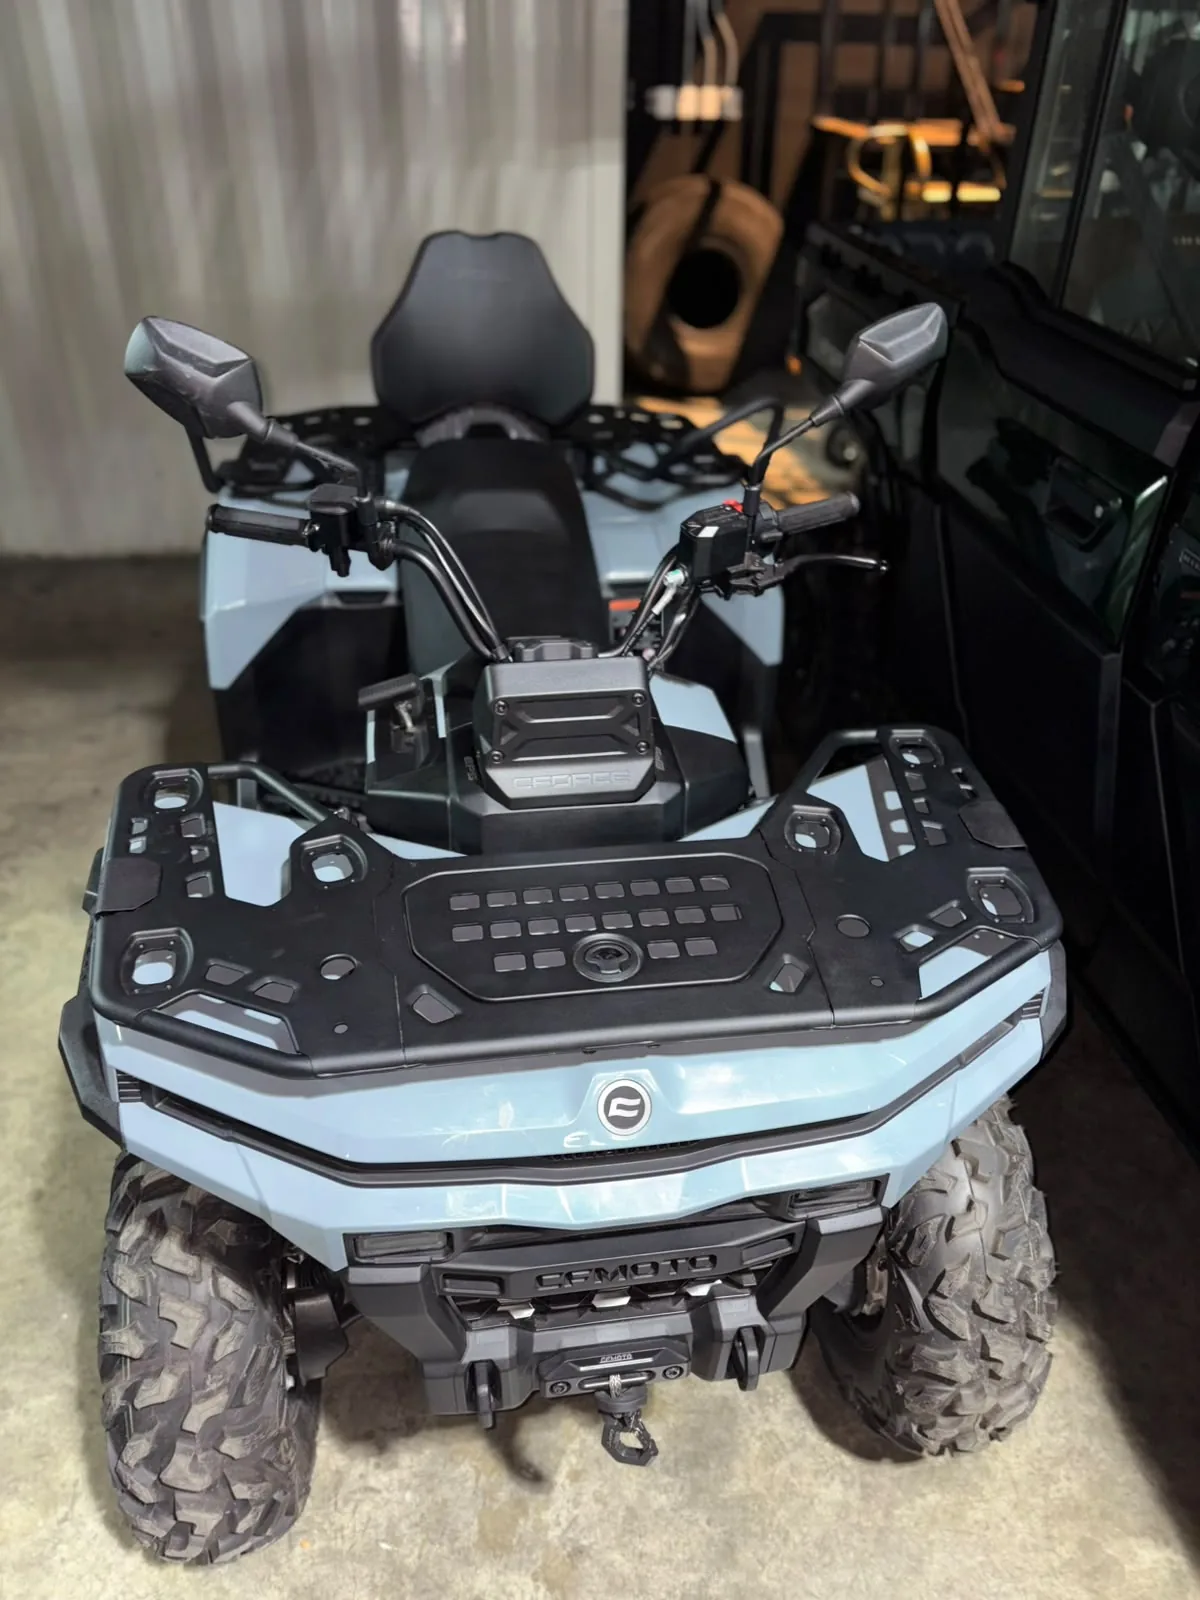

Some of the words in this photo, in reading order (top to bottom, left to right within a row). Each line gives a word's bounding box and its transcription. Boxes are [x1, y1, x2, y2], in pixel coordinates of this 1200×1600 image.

[513, 769, 631, 789] CFORCE
[534, 1254, 718, 1291] CFMOTO
[599, 1353, 633, 1364] CFMOTO
